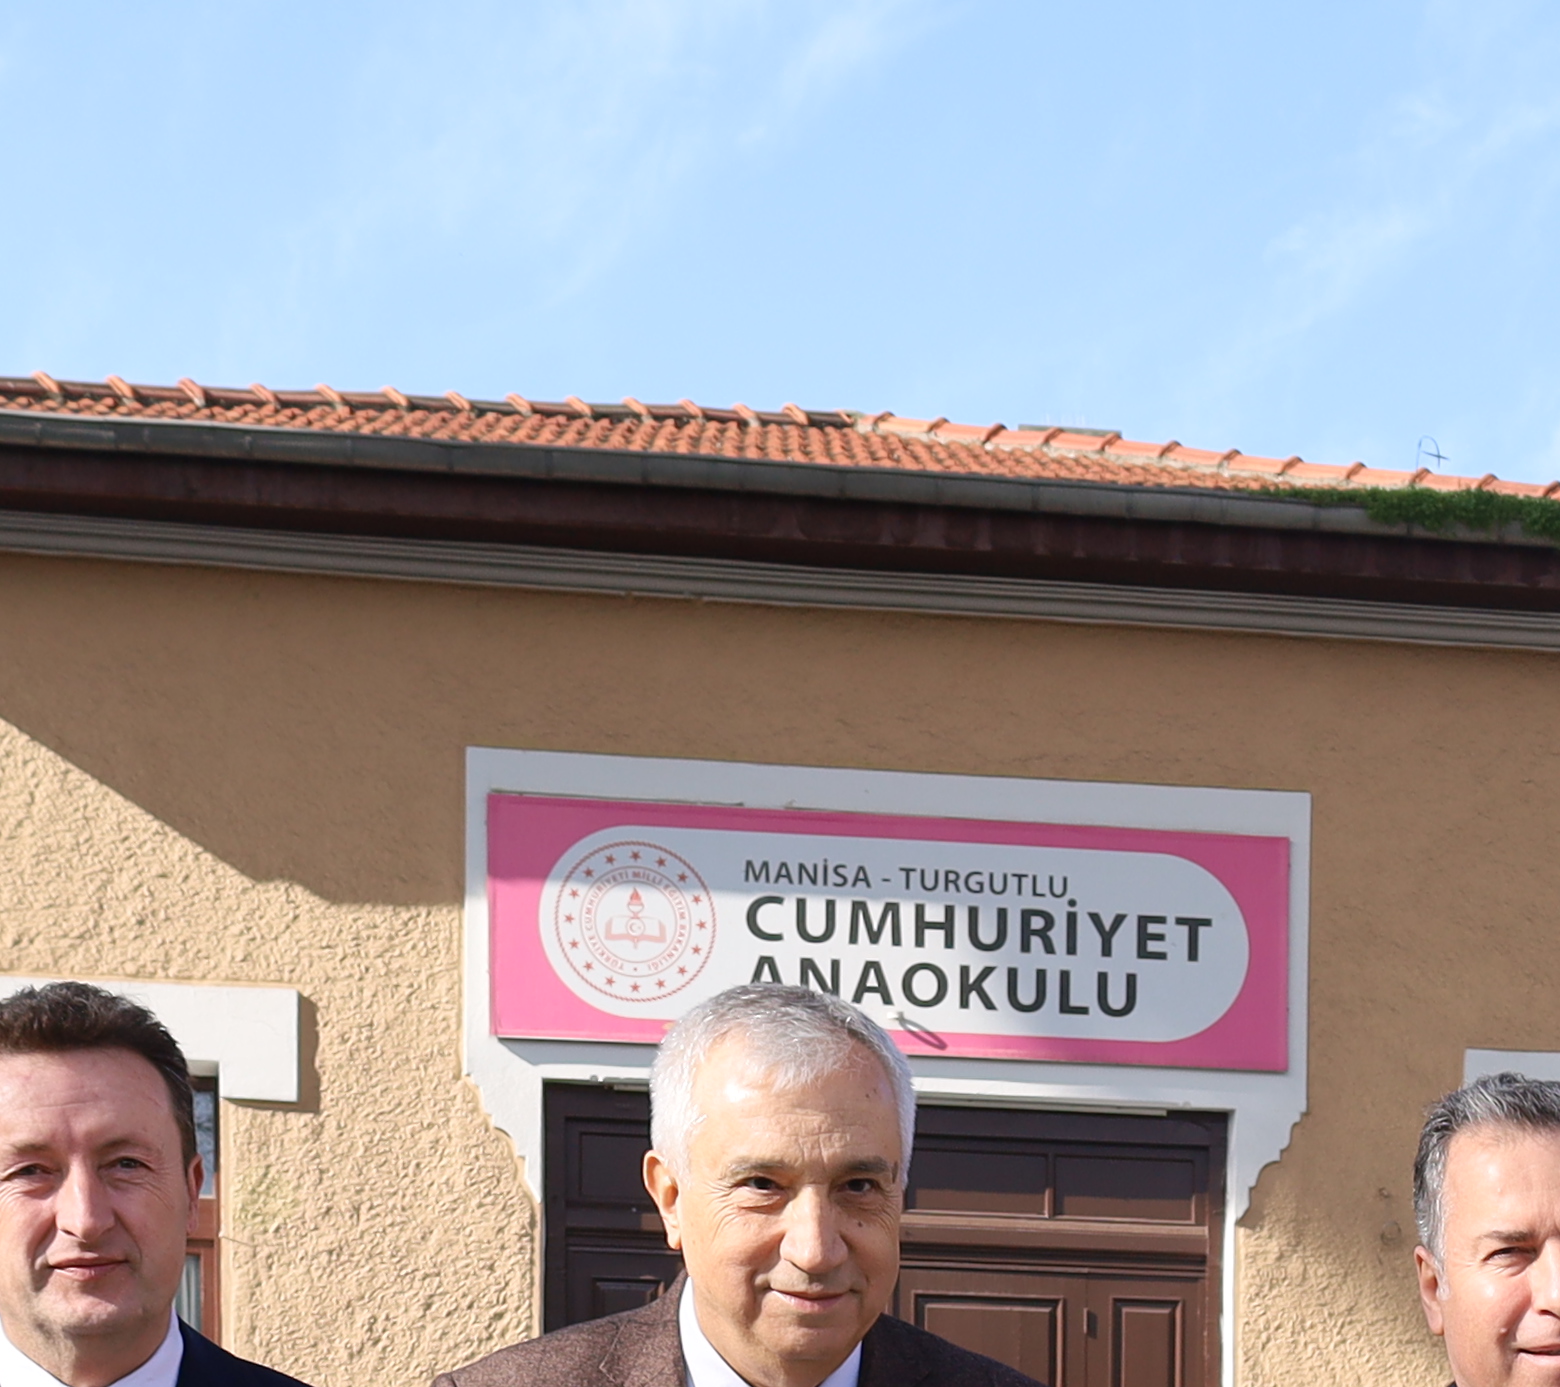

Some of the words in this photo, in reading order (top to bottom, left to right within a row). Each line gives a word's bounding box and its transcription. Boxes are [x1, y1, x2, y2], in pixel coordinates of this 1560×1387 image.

[744, 858, 872, 888] MANİSA
[898, 867, 1068, 898] TURGUTLU
[745, 895, 1213, 962] CUMHURİYET
[749, 955, 1138, 1018] ANAOKULU
